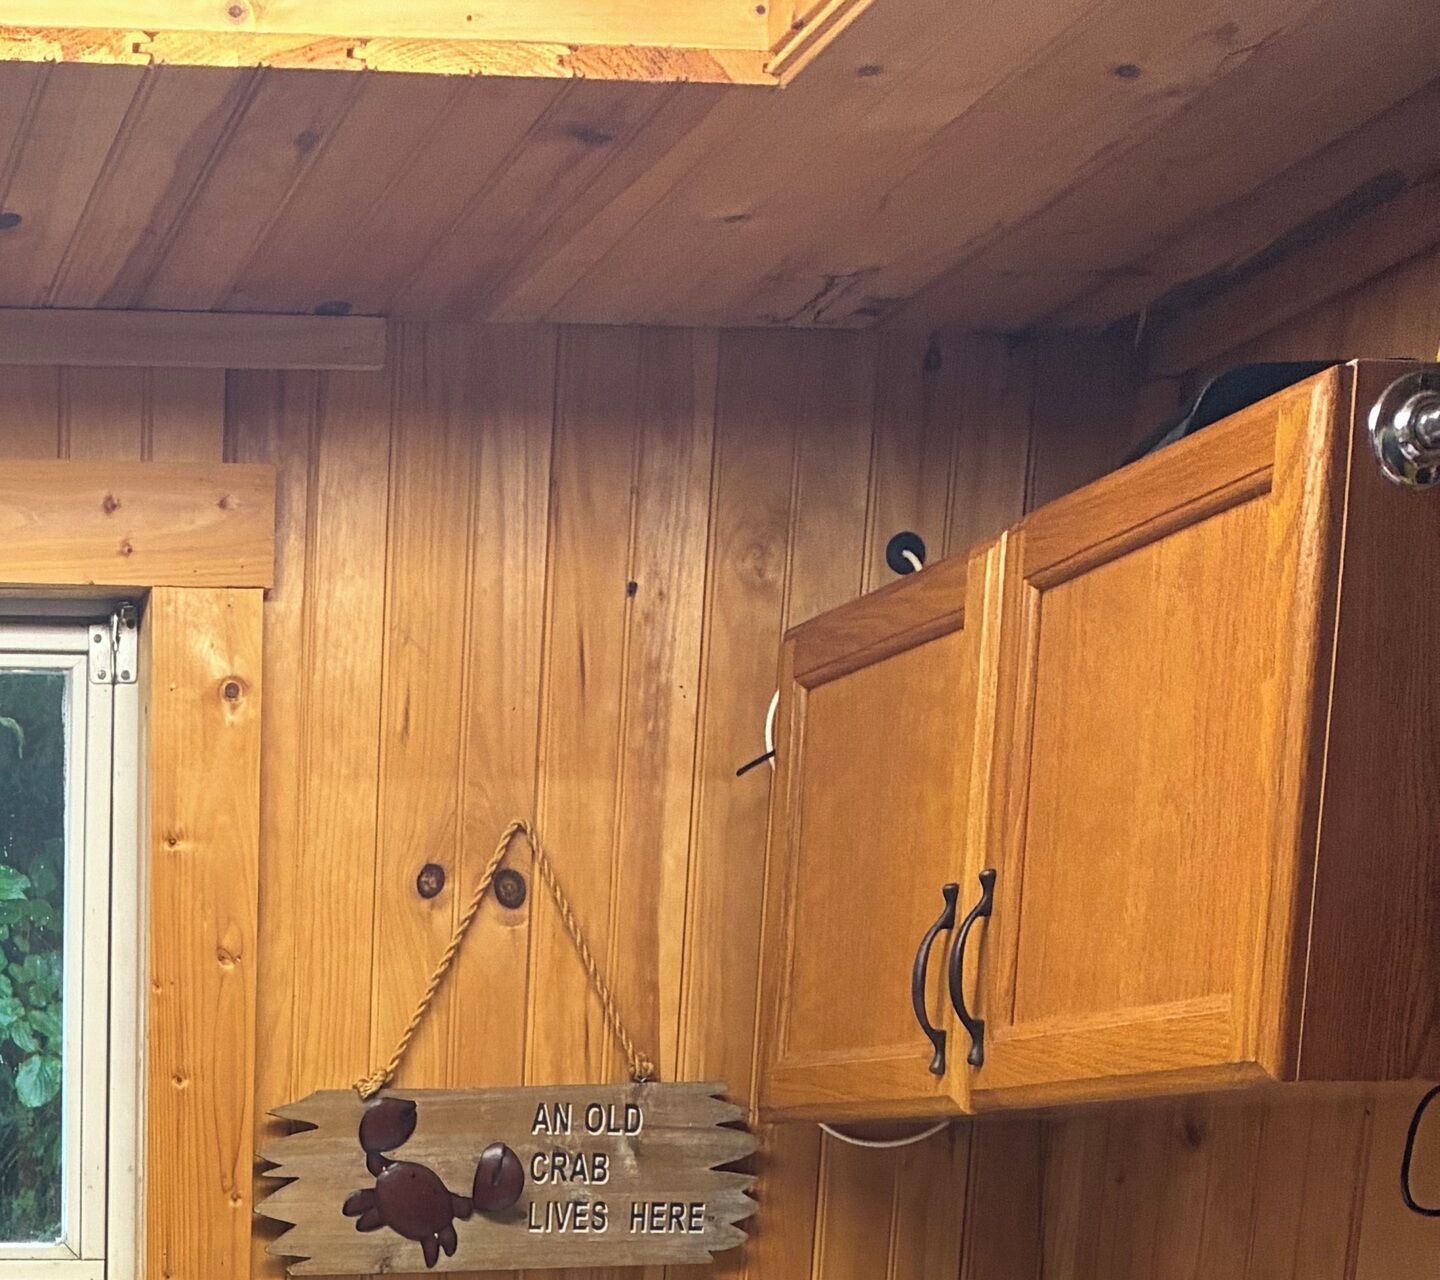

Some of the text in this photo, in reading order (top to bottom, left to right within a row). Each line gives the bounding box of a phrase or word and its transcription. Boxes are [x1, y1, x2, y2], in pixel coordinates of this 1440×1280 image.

[531, 1102, 644, 1136] AN OLD
[530, 1151, 610, 1185] CRAB
[528, 1201, 706, 1234] LIVES HERE
